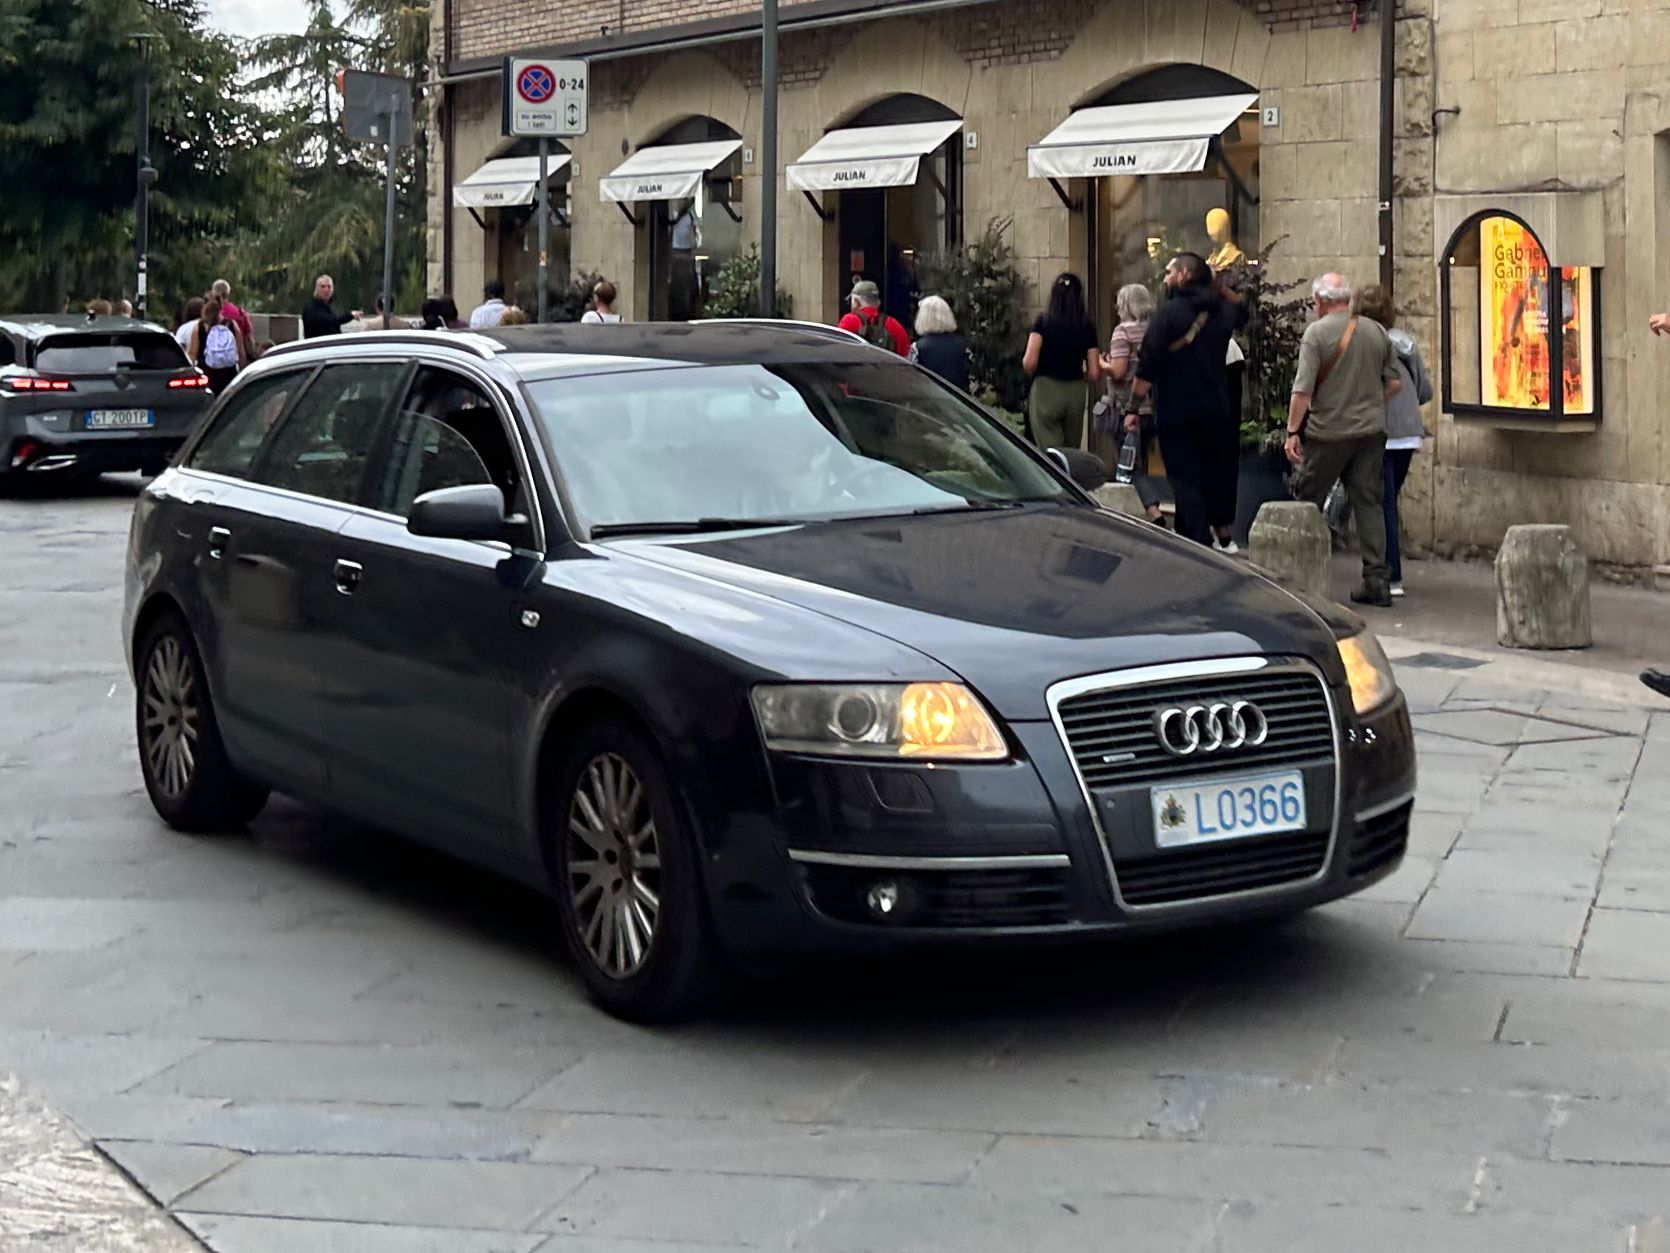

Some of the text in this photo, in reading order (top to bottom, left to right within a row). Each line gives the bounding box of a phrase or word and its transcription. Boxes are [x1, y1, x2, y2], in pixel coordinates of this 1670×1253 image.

[559, 77, 585, 91] 0-24
[1267, 110, 1274, 122] 2
[1093, 154, 1137, 168] JULIAN
[833, 170, 866, 182] JULIAN
[637, 183, 663, 194] JULIAN
[1194, 781, 1301, 835] L0366
